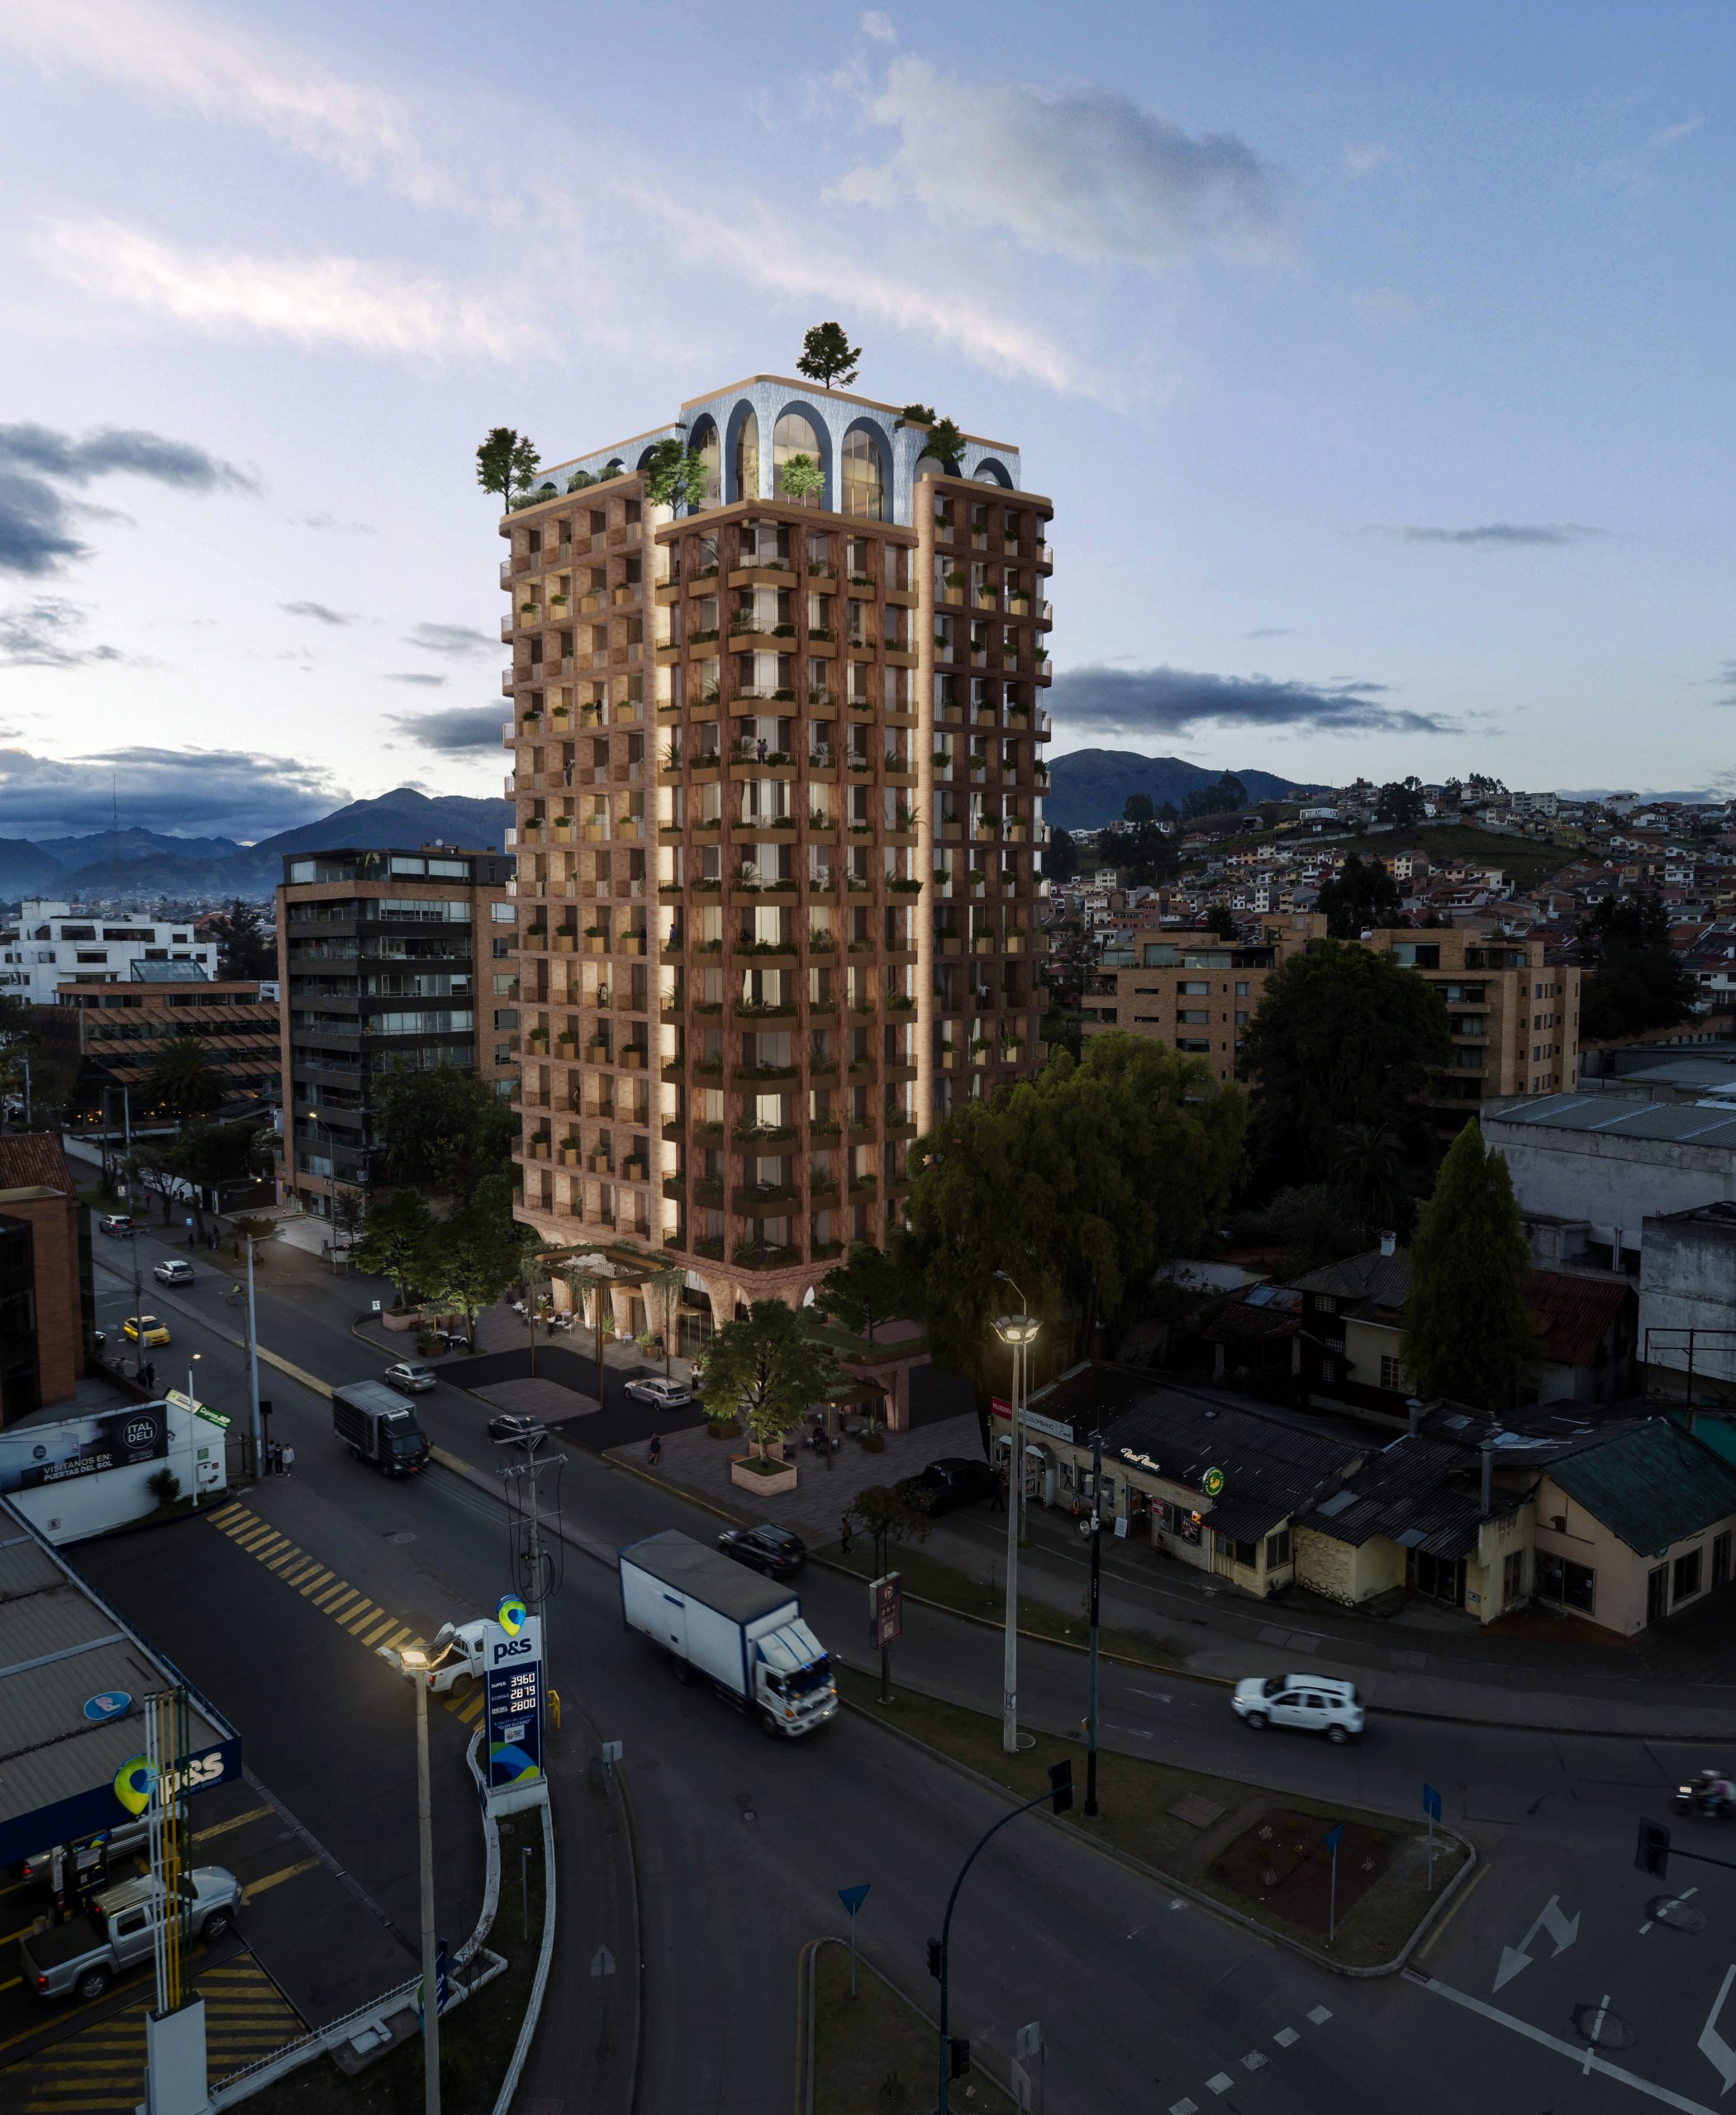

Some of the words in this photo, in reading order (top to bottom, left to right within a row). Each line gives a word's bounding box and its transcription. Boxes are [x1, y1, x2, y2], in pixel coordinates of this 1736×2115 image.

[126, 1421, 153, 1434] ITAL
[128, 1431, 154, 1442] DELI
[43, 1456, 95, 1475] VISITANOS
[97, 1453, 113, 1461] EN:
[44, 1467, 79, 1481] PUERTAS
[80, 1464, 97, 1473] DEL
[97, 1461, 113, 1469] SOL
